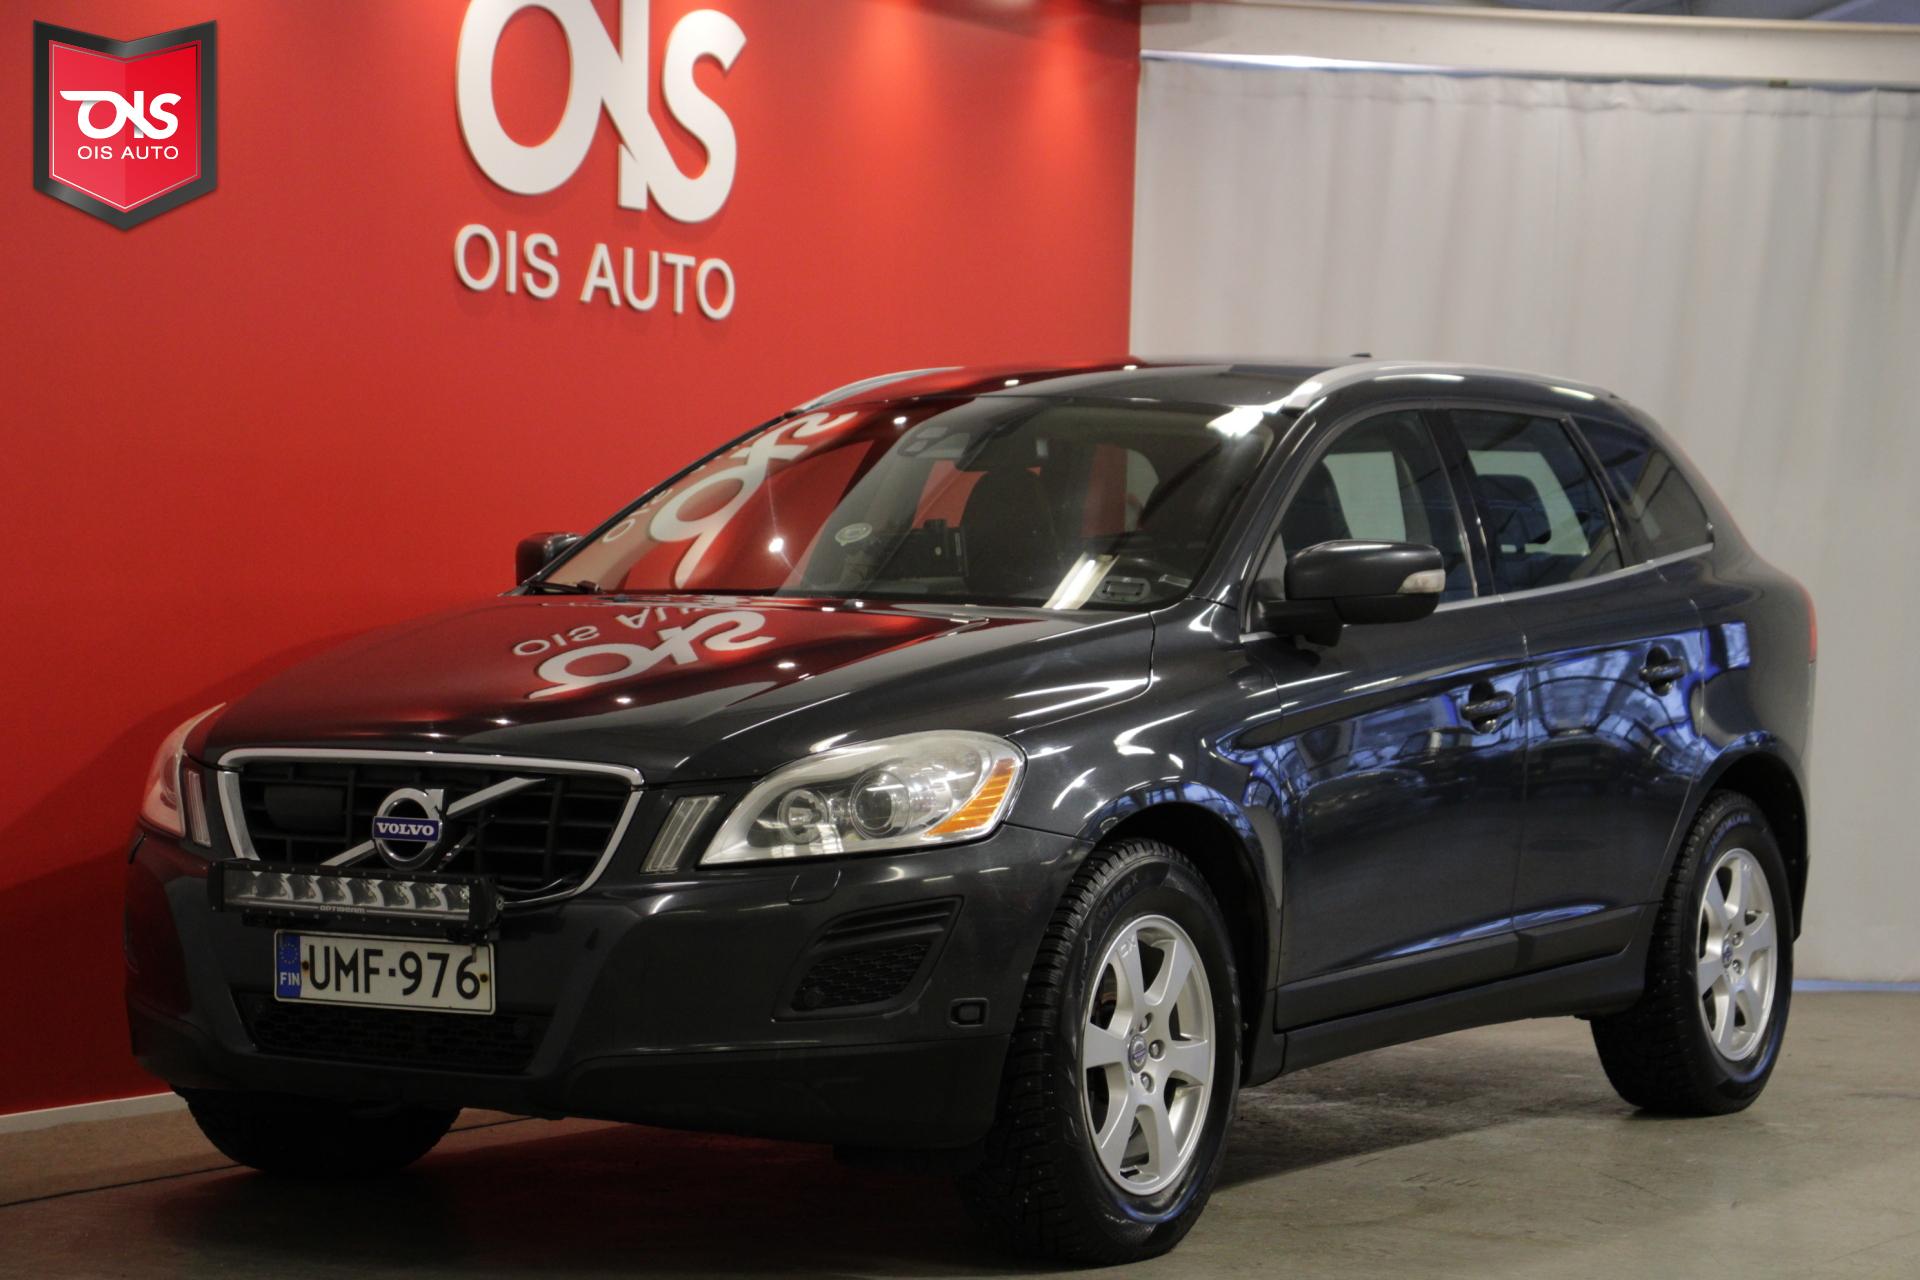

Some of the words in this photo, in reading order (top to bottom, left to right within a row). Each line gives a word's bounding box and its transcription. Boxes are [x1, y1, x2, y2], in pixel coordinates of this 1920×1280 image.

[455, 0, 748, 223] OIS
[454, 223, 560, 299] OIS
[580, 242, 736, 320] AUTO
[376, 822, 435, 836] VOLVO
[279, 971, 300, 986] FIN
[309, 944, 481, 1000] UMF-976
